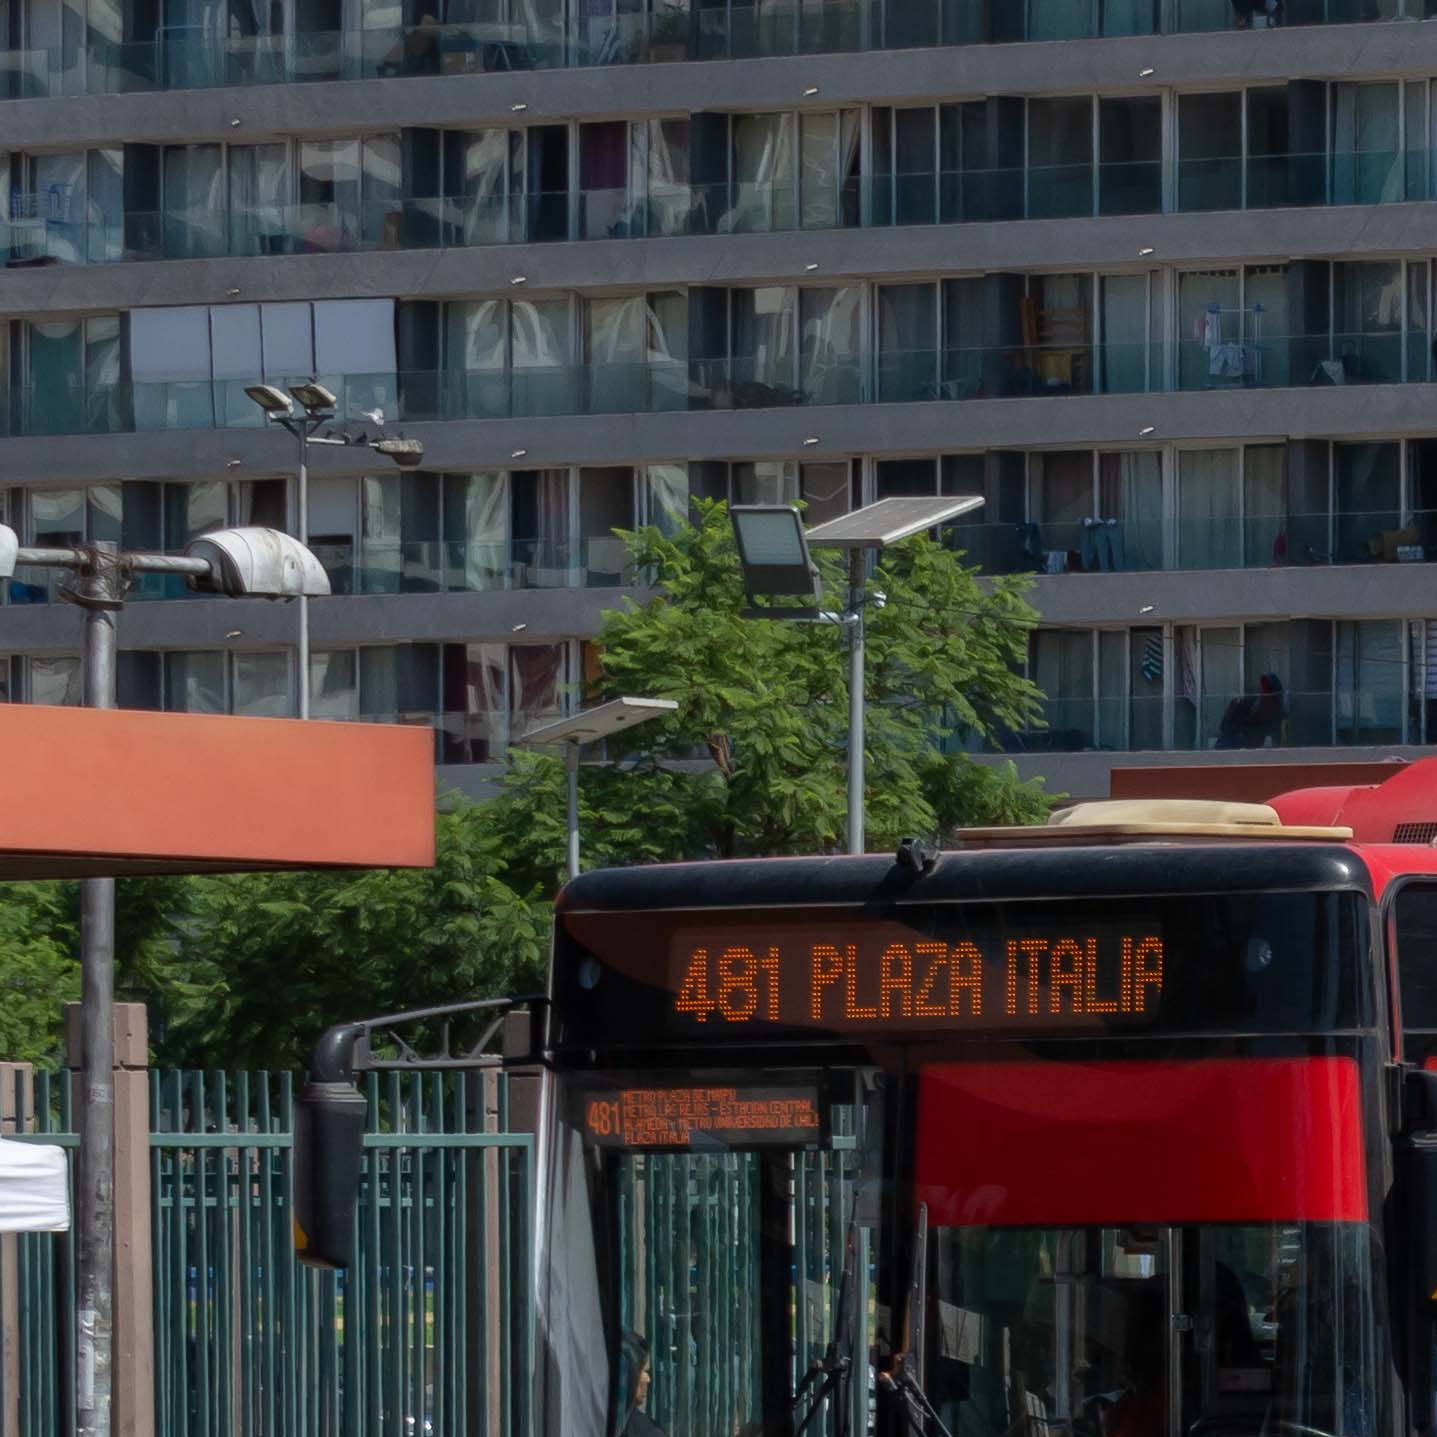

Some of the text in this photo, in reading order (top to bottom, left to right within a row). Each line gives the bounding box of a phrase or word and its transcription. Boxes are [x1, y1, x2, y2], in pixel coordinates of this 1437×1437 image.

[675, 936, 1164, 1022] 481 PLAZA ITALIA
[587, 1102, 621, 1136] 481
